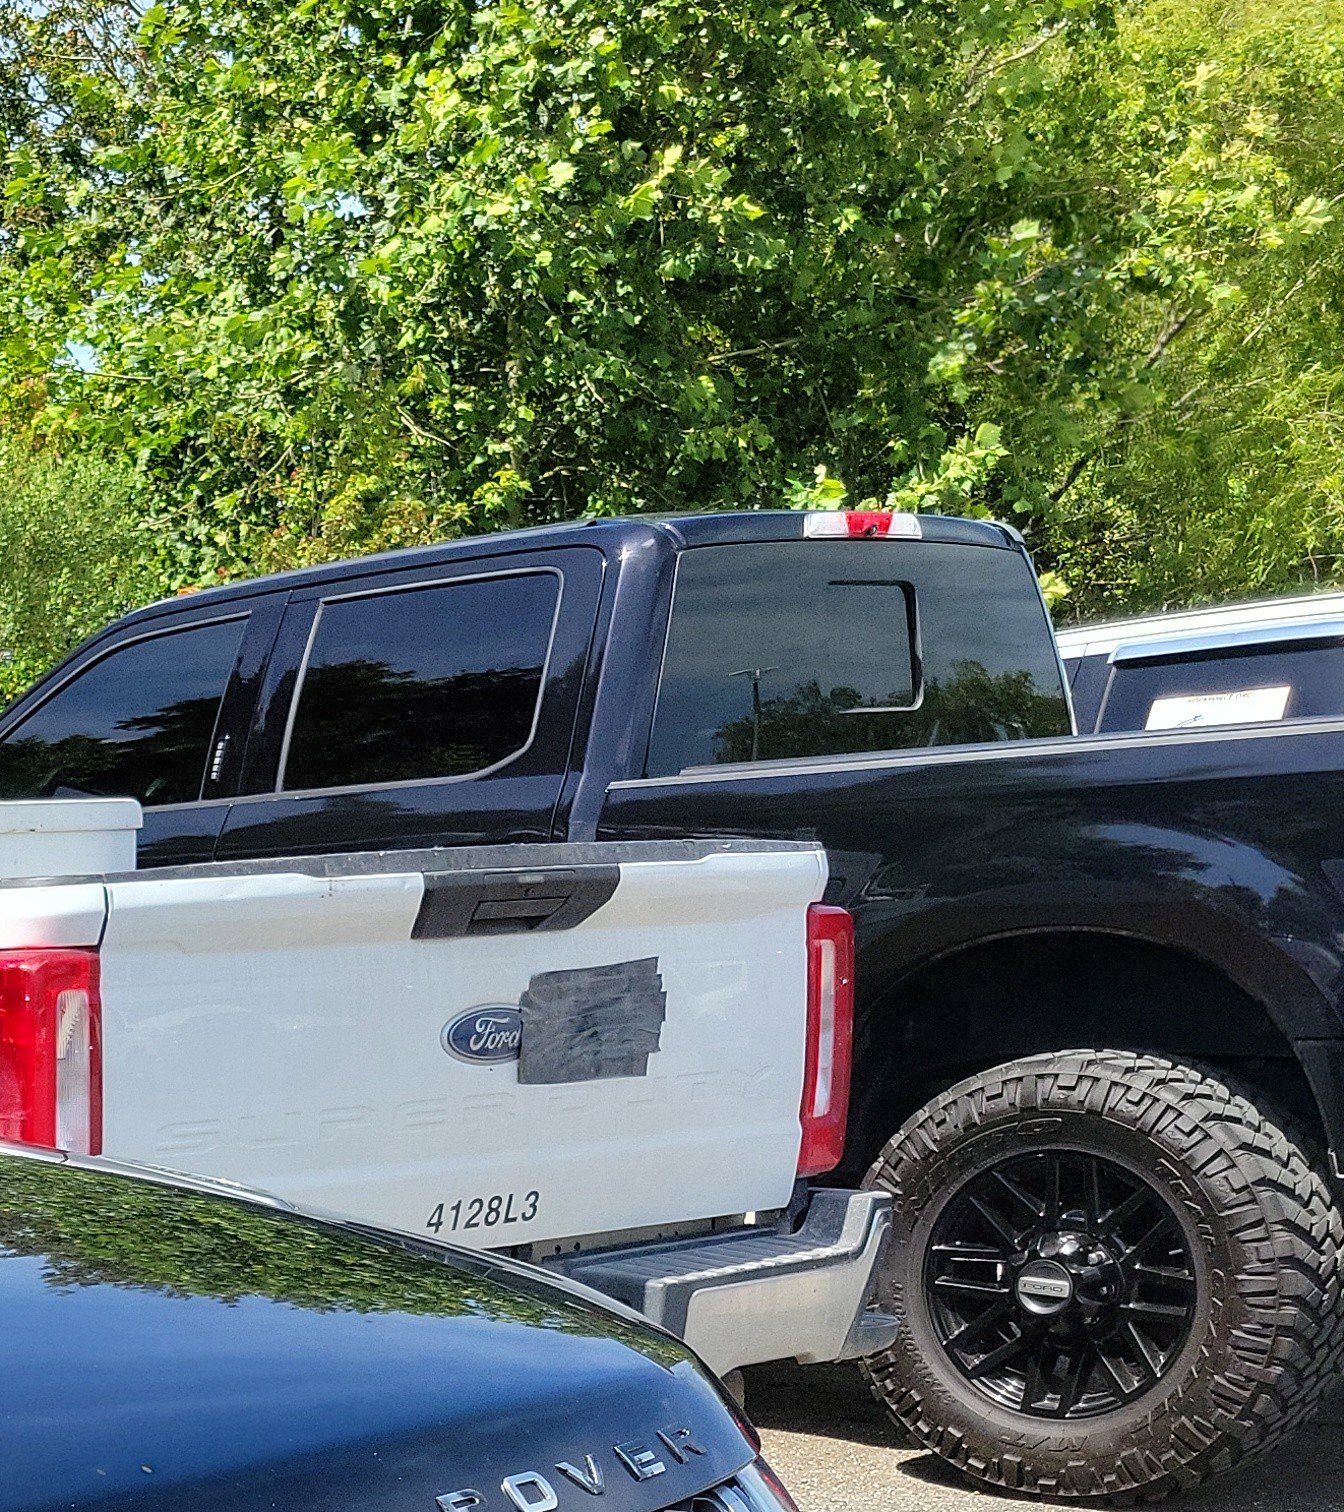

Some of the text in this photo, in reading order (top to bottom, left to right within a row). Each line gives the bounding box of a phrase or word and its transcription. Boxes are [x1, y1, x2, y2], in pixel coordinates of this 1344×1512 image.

[470, 1016, 521, 1051] Ford
[155, 1091, 516, 1156] SUPER
[426, 1190, 540, 1234] 4128L3
[1023, 1282, 1063, 1292] FORD
